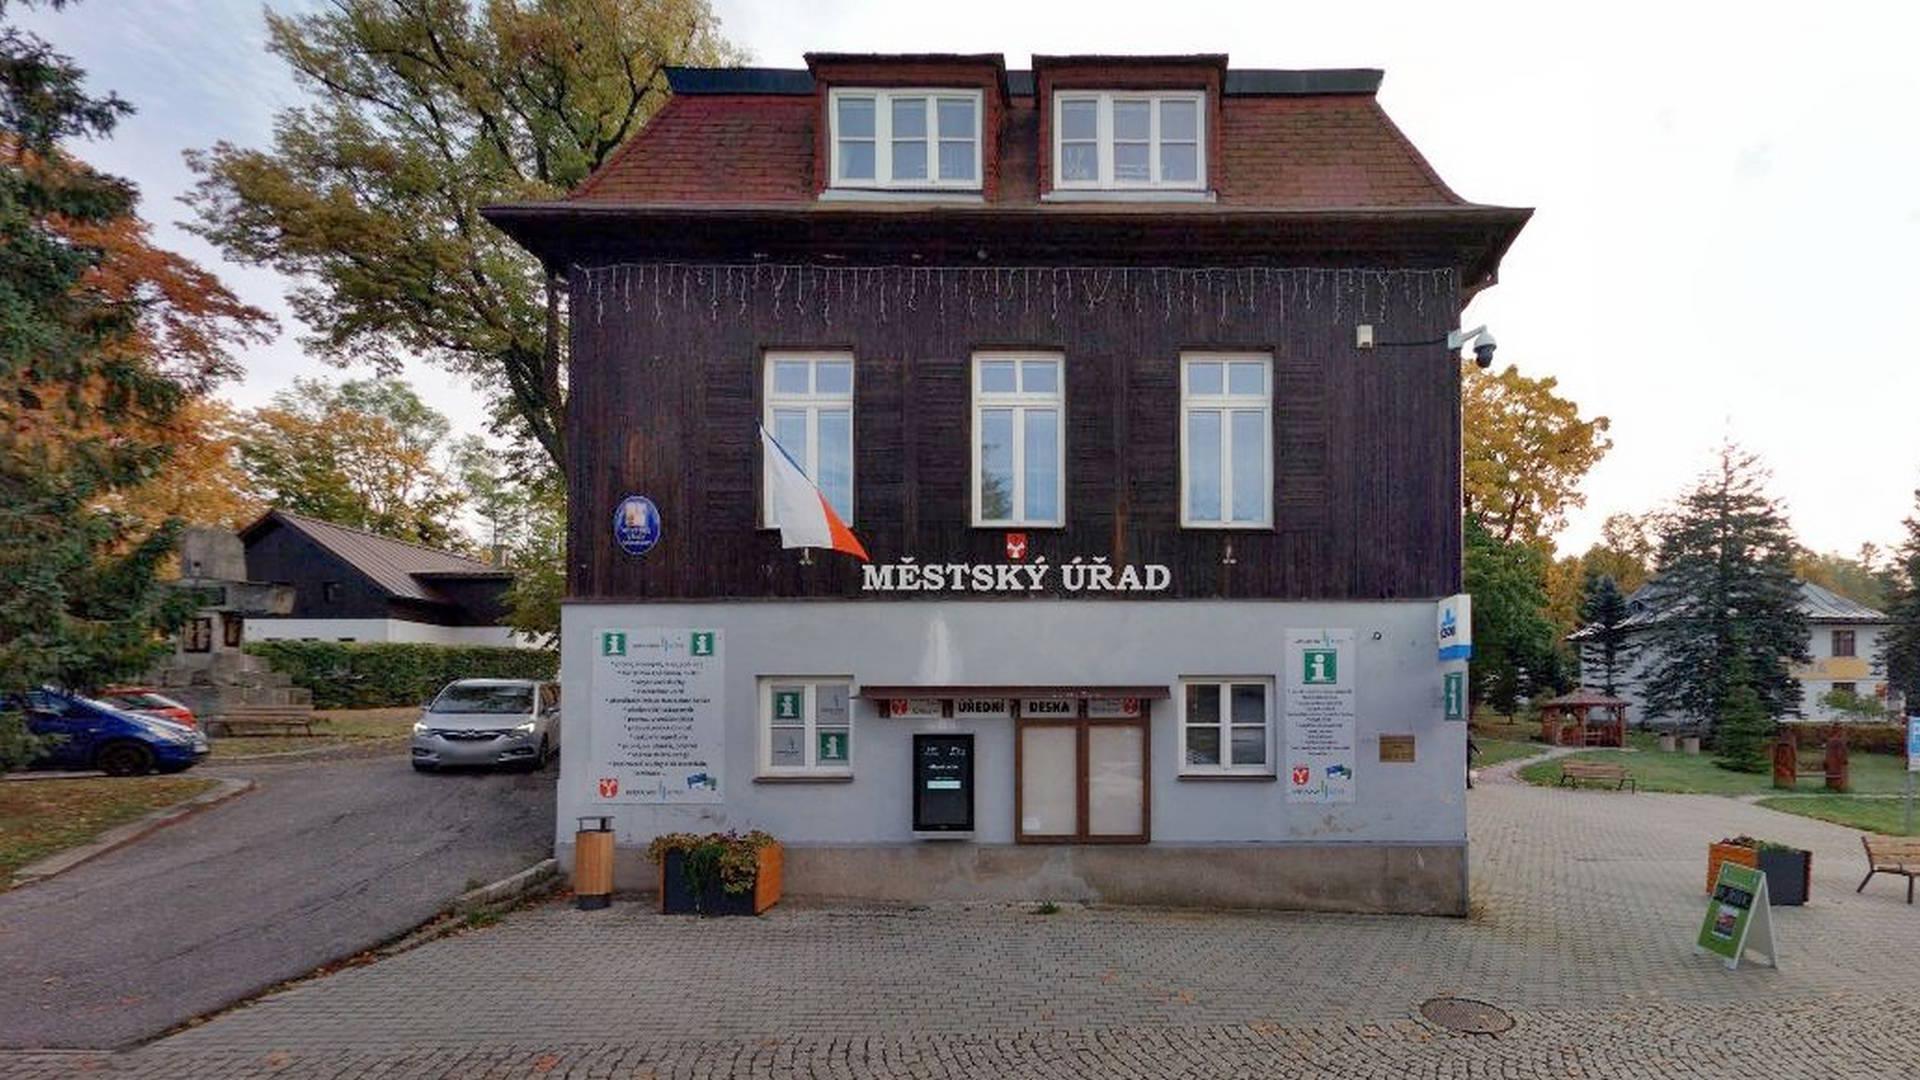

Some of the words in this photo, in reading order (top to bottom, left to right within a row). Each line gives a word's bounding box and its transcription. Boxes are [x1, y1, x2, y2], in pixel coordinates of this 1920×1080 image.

[861, 557, 1049, 591] MĚSTSKÝ
[1061, 557, 1172, 591] ÚŘAD
[958, 698, 1006, 713] ÚŘEDNÍ
[1029, 700, 1071, 713] DESKA
